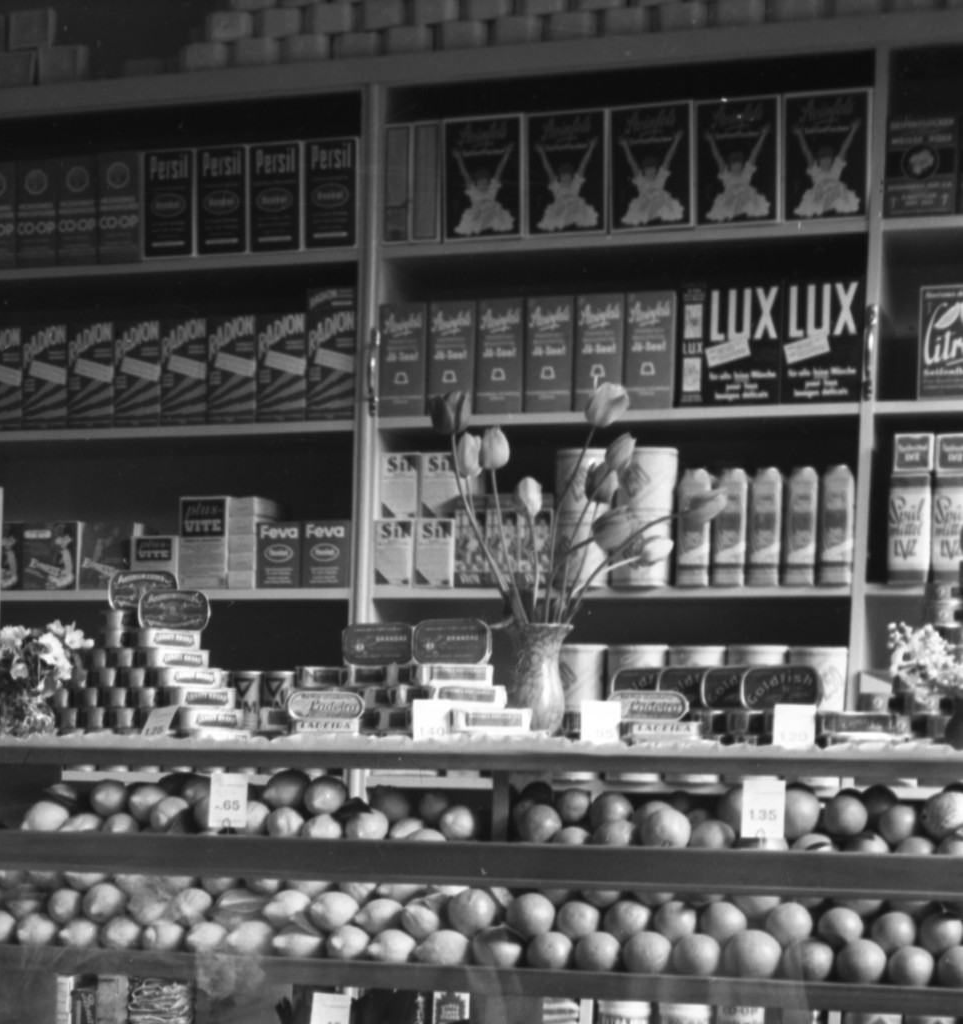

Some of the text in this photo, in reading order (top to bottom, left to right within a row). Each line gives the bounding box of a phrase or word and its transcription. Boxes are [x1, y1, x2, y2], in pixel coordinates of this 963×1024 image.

[149, 154, 188, 181] Persil
[202, 150, 242, 178] Persil
[255, 147, 296, 175] Persil
[310, 143, 352, 170] Persil
[710, 286, 779, 342] LUX
[788, 281, 859, 338] LUX
[24, 325, 67, 370] RADION
[68, 322, 113, 368] RADION
[115, 319, 159, 365] RADION
[161, 318, 207, 364] RADION
[208, 315, 255, 362] RADION
[258, 313, 306, 361] RADION
[308, 311, 354, 358] RADION
[682, 341, 703, 356] LUX
[184, 519, 222, 533] VITE
[260, 525, 299, 540] Feva
[305, 523, 345, 539] Feva
[137, 549, 170, 559] VITE
[747, 670, 815, 706] Goldfish
[749, 809, 777, 821] 1.35
